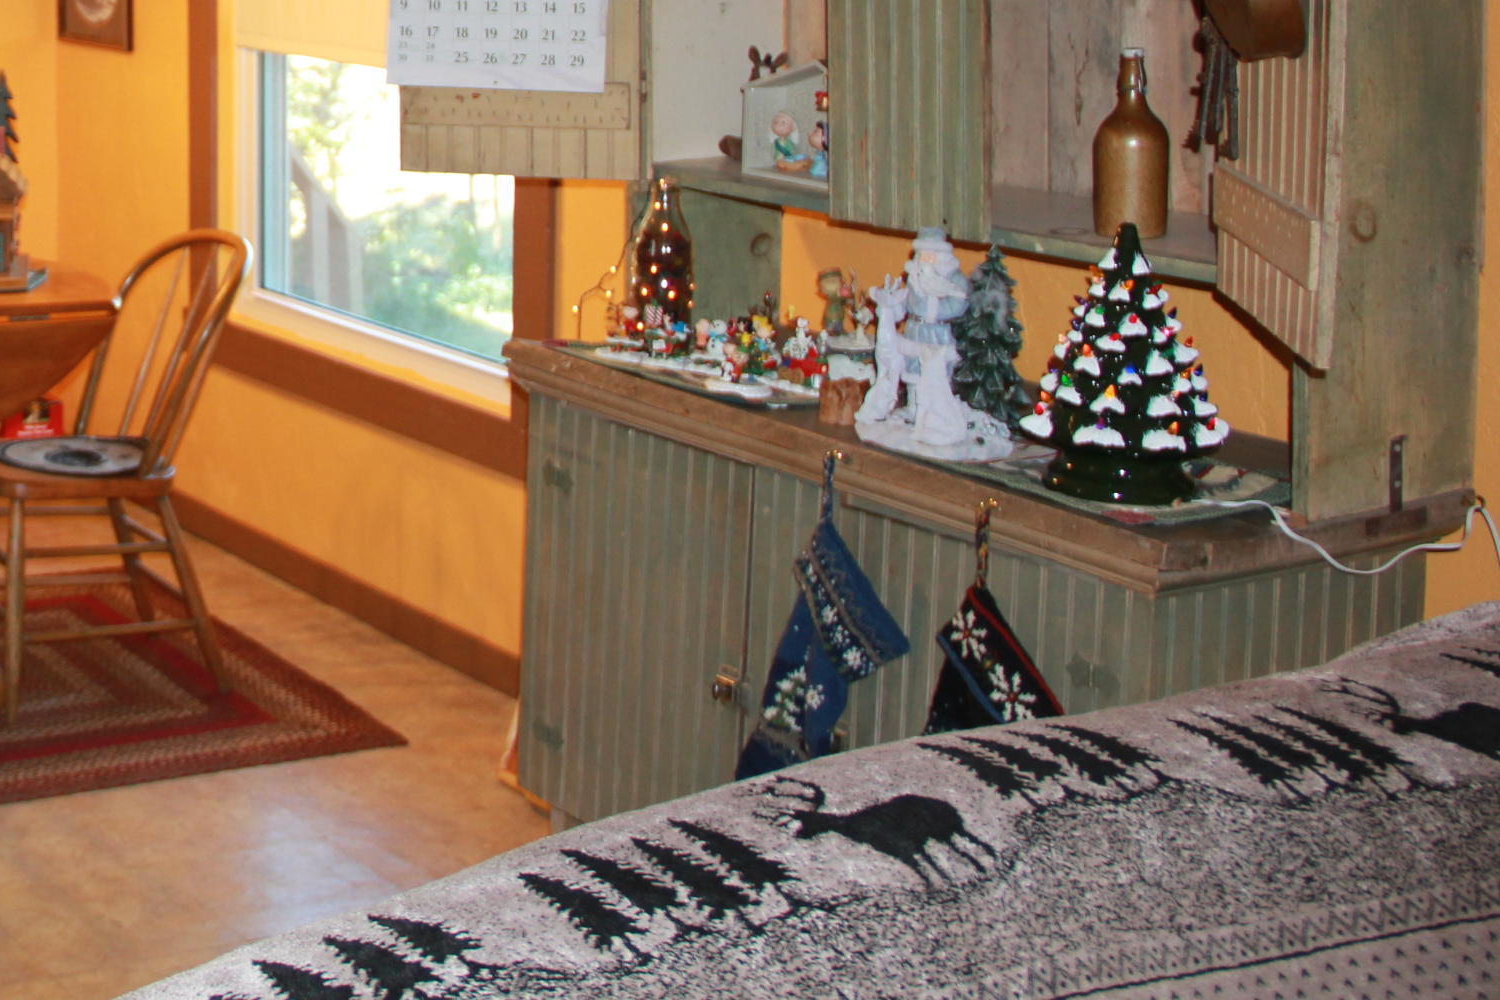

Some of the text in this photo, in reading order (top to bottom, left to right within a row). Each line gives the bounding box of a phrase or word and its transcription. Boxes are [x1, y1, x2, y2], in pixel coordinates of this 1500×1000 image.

[400, 0, 585, 13] 9 10 11 12 13 14 15
[399, 26, 586, 41] 16 17 18 19 20 21 22
[455, 52, 468, 63] 25
[483, 53, 497, 64] 26
[512, 54, 526, 65] 27
[541, 54, 555, 66] 28
[570, 55, 584, 66] 29
